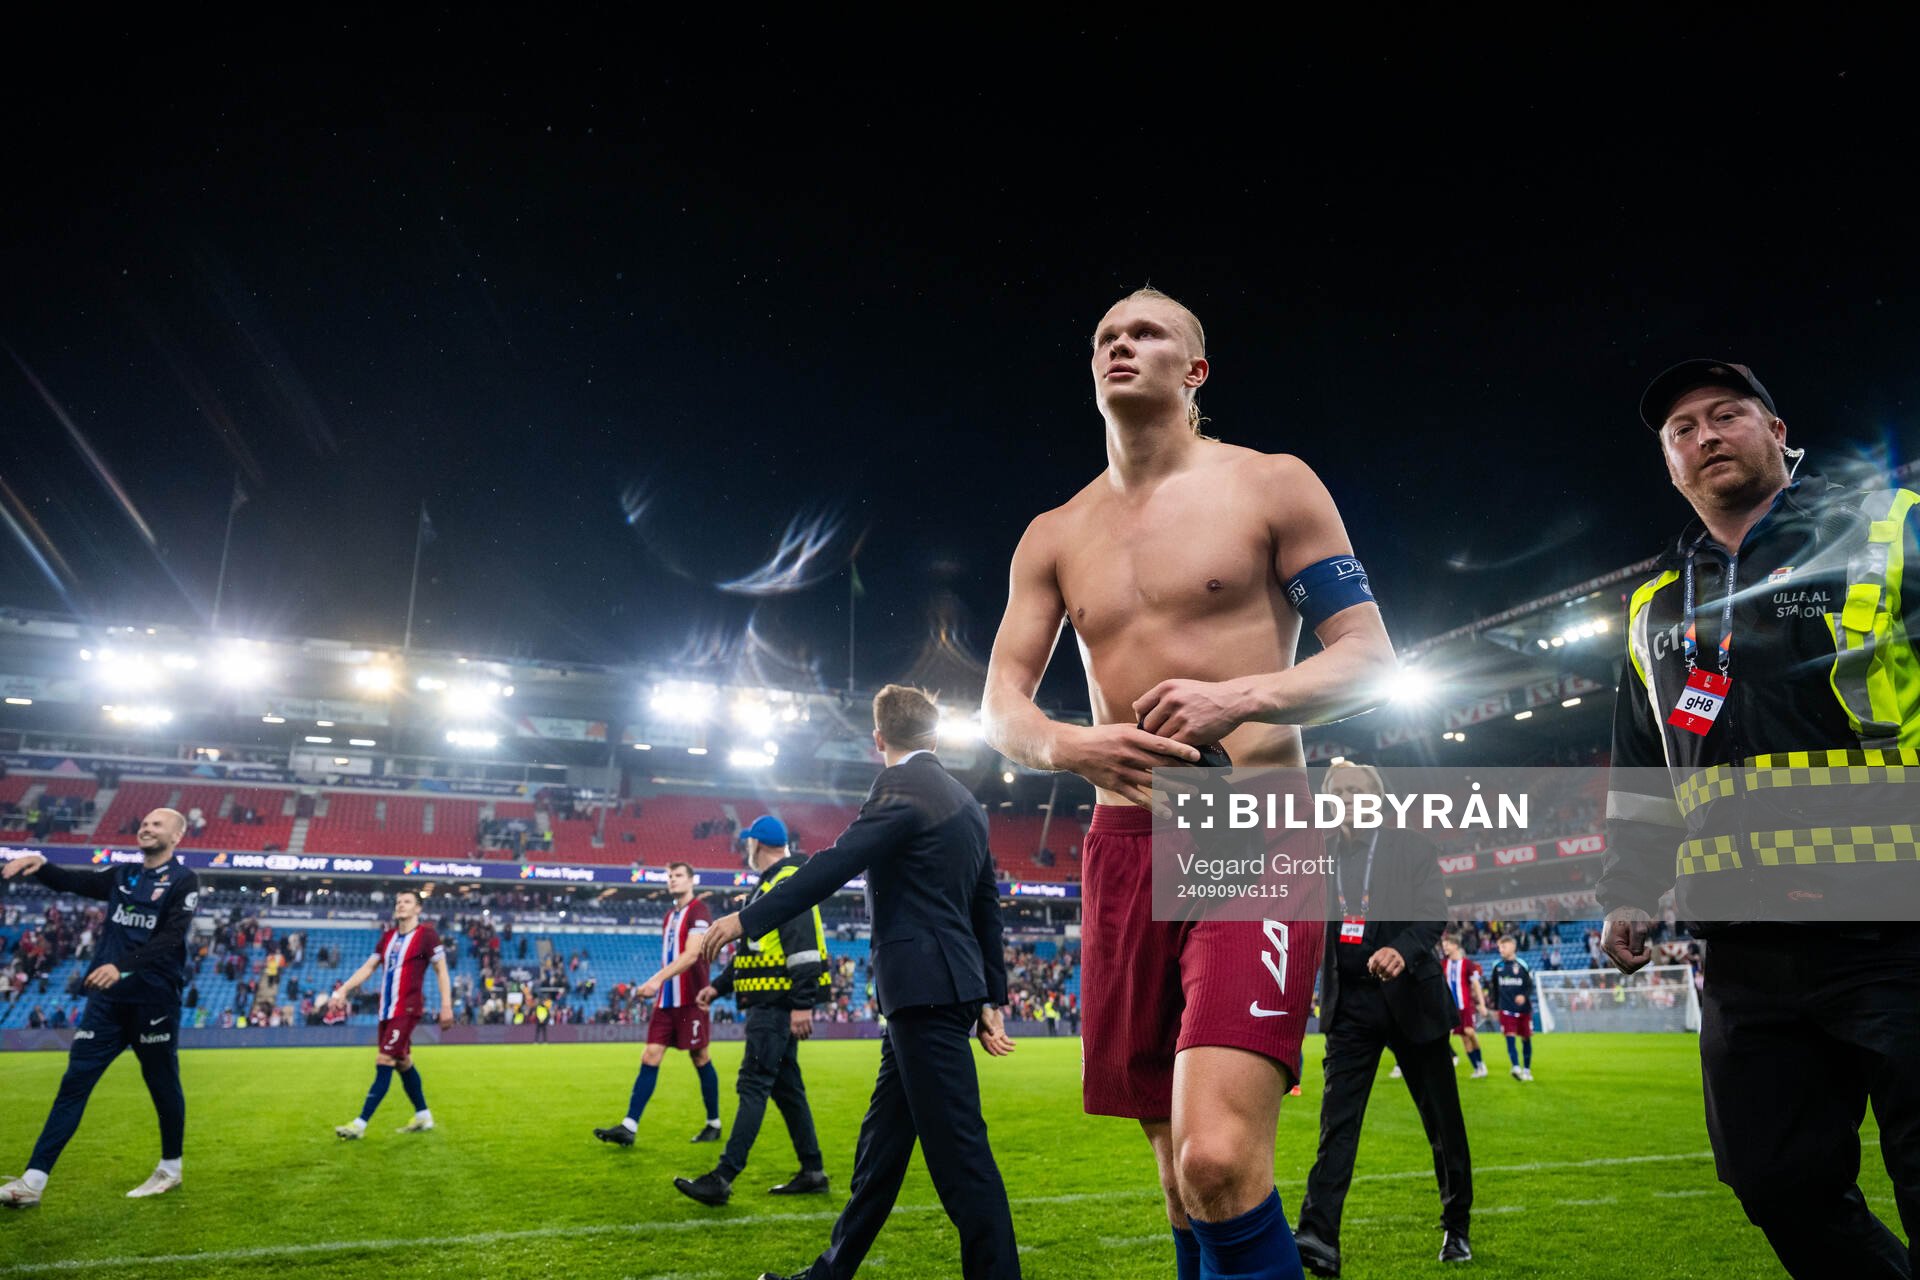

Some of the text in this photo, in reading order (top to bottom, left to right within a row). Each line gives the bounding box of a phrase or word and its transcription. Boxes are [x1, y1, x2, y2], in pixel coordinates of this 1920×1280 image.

[1684, 695, 1714, 713] gH8
[1558, 836, 1602, 855] VG
[1438, 856, 1474, 873] VG
[1495, 847, 1534, 865] VG
[419, 862, 482, 878] Norsk Tipping
[535, 867, 594, 882] Norsk Tipping
[111, 903, 157, 930] bama
[140, 1031, 171, 1045] bama
